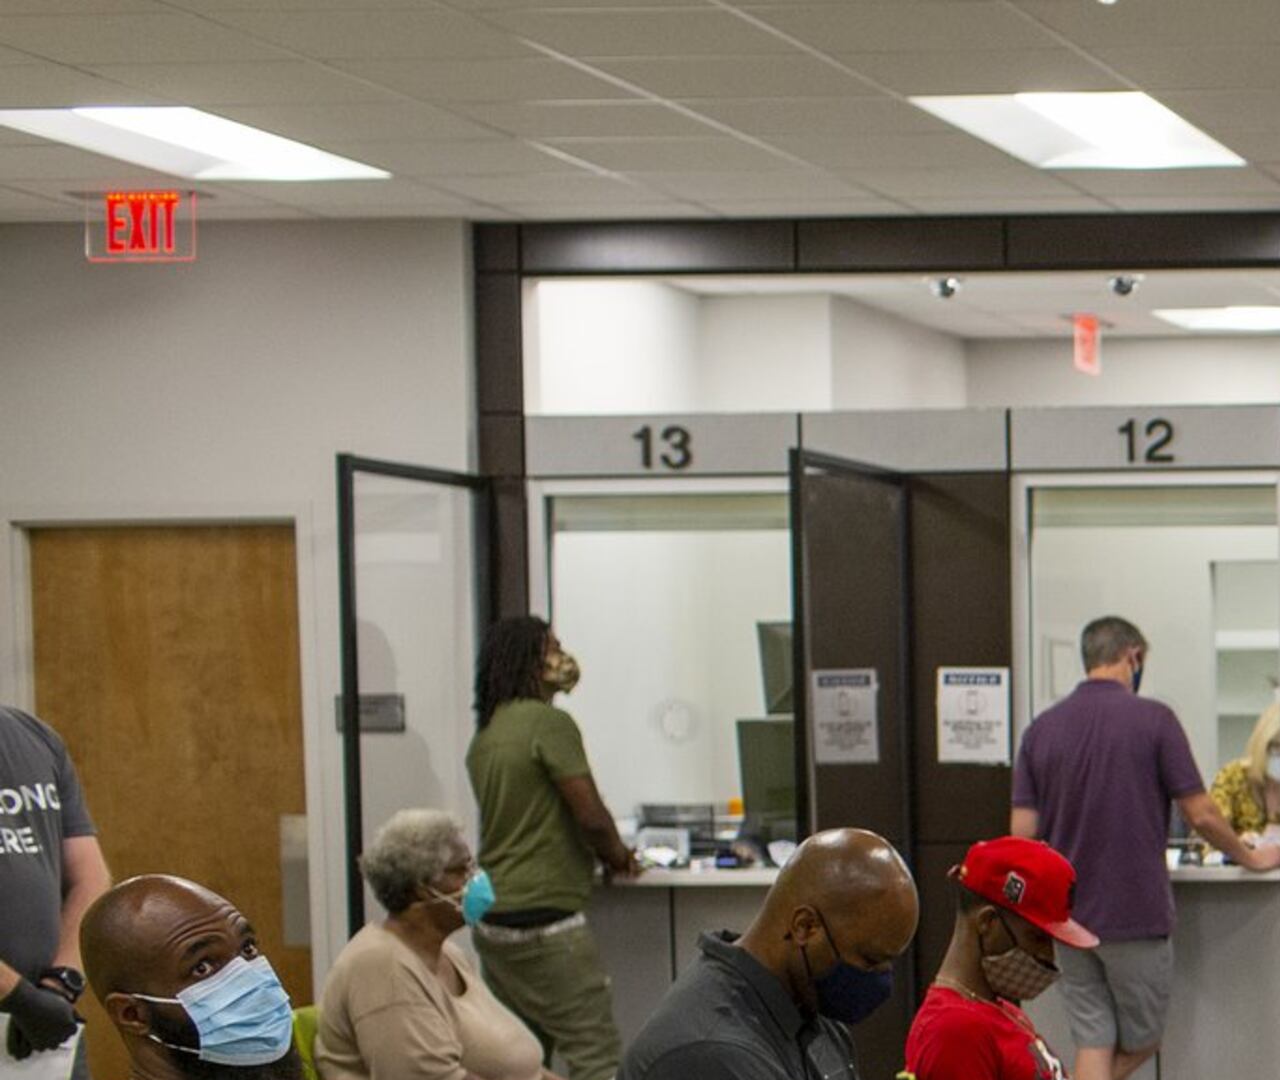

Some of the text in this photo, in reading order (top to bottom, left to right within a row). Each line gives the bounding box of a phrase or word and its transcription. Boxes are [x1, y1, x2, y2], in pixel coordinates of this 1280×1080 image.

[106, 191, 178, 253] EXIT
[632, 424, 692, 470] 13
[1118, 417, 1175, 463] 12
